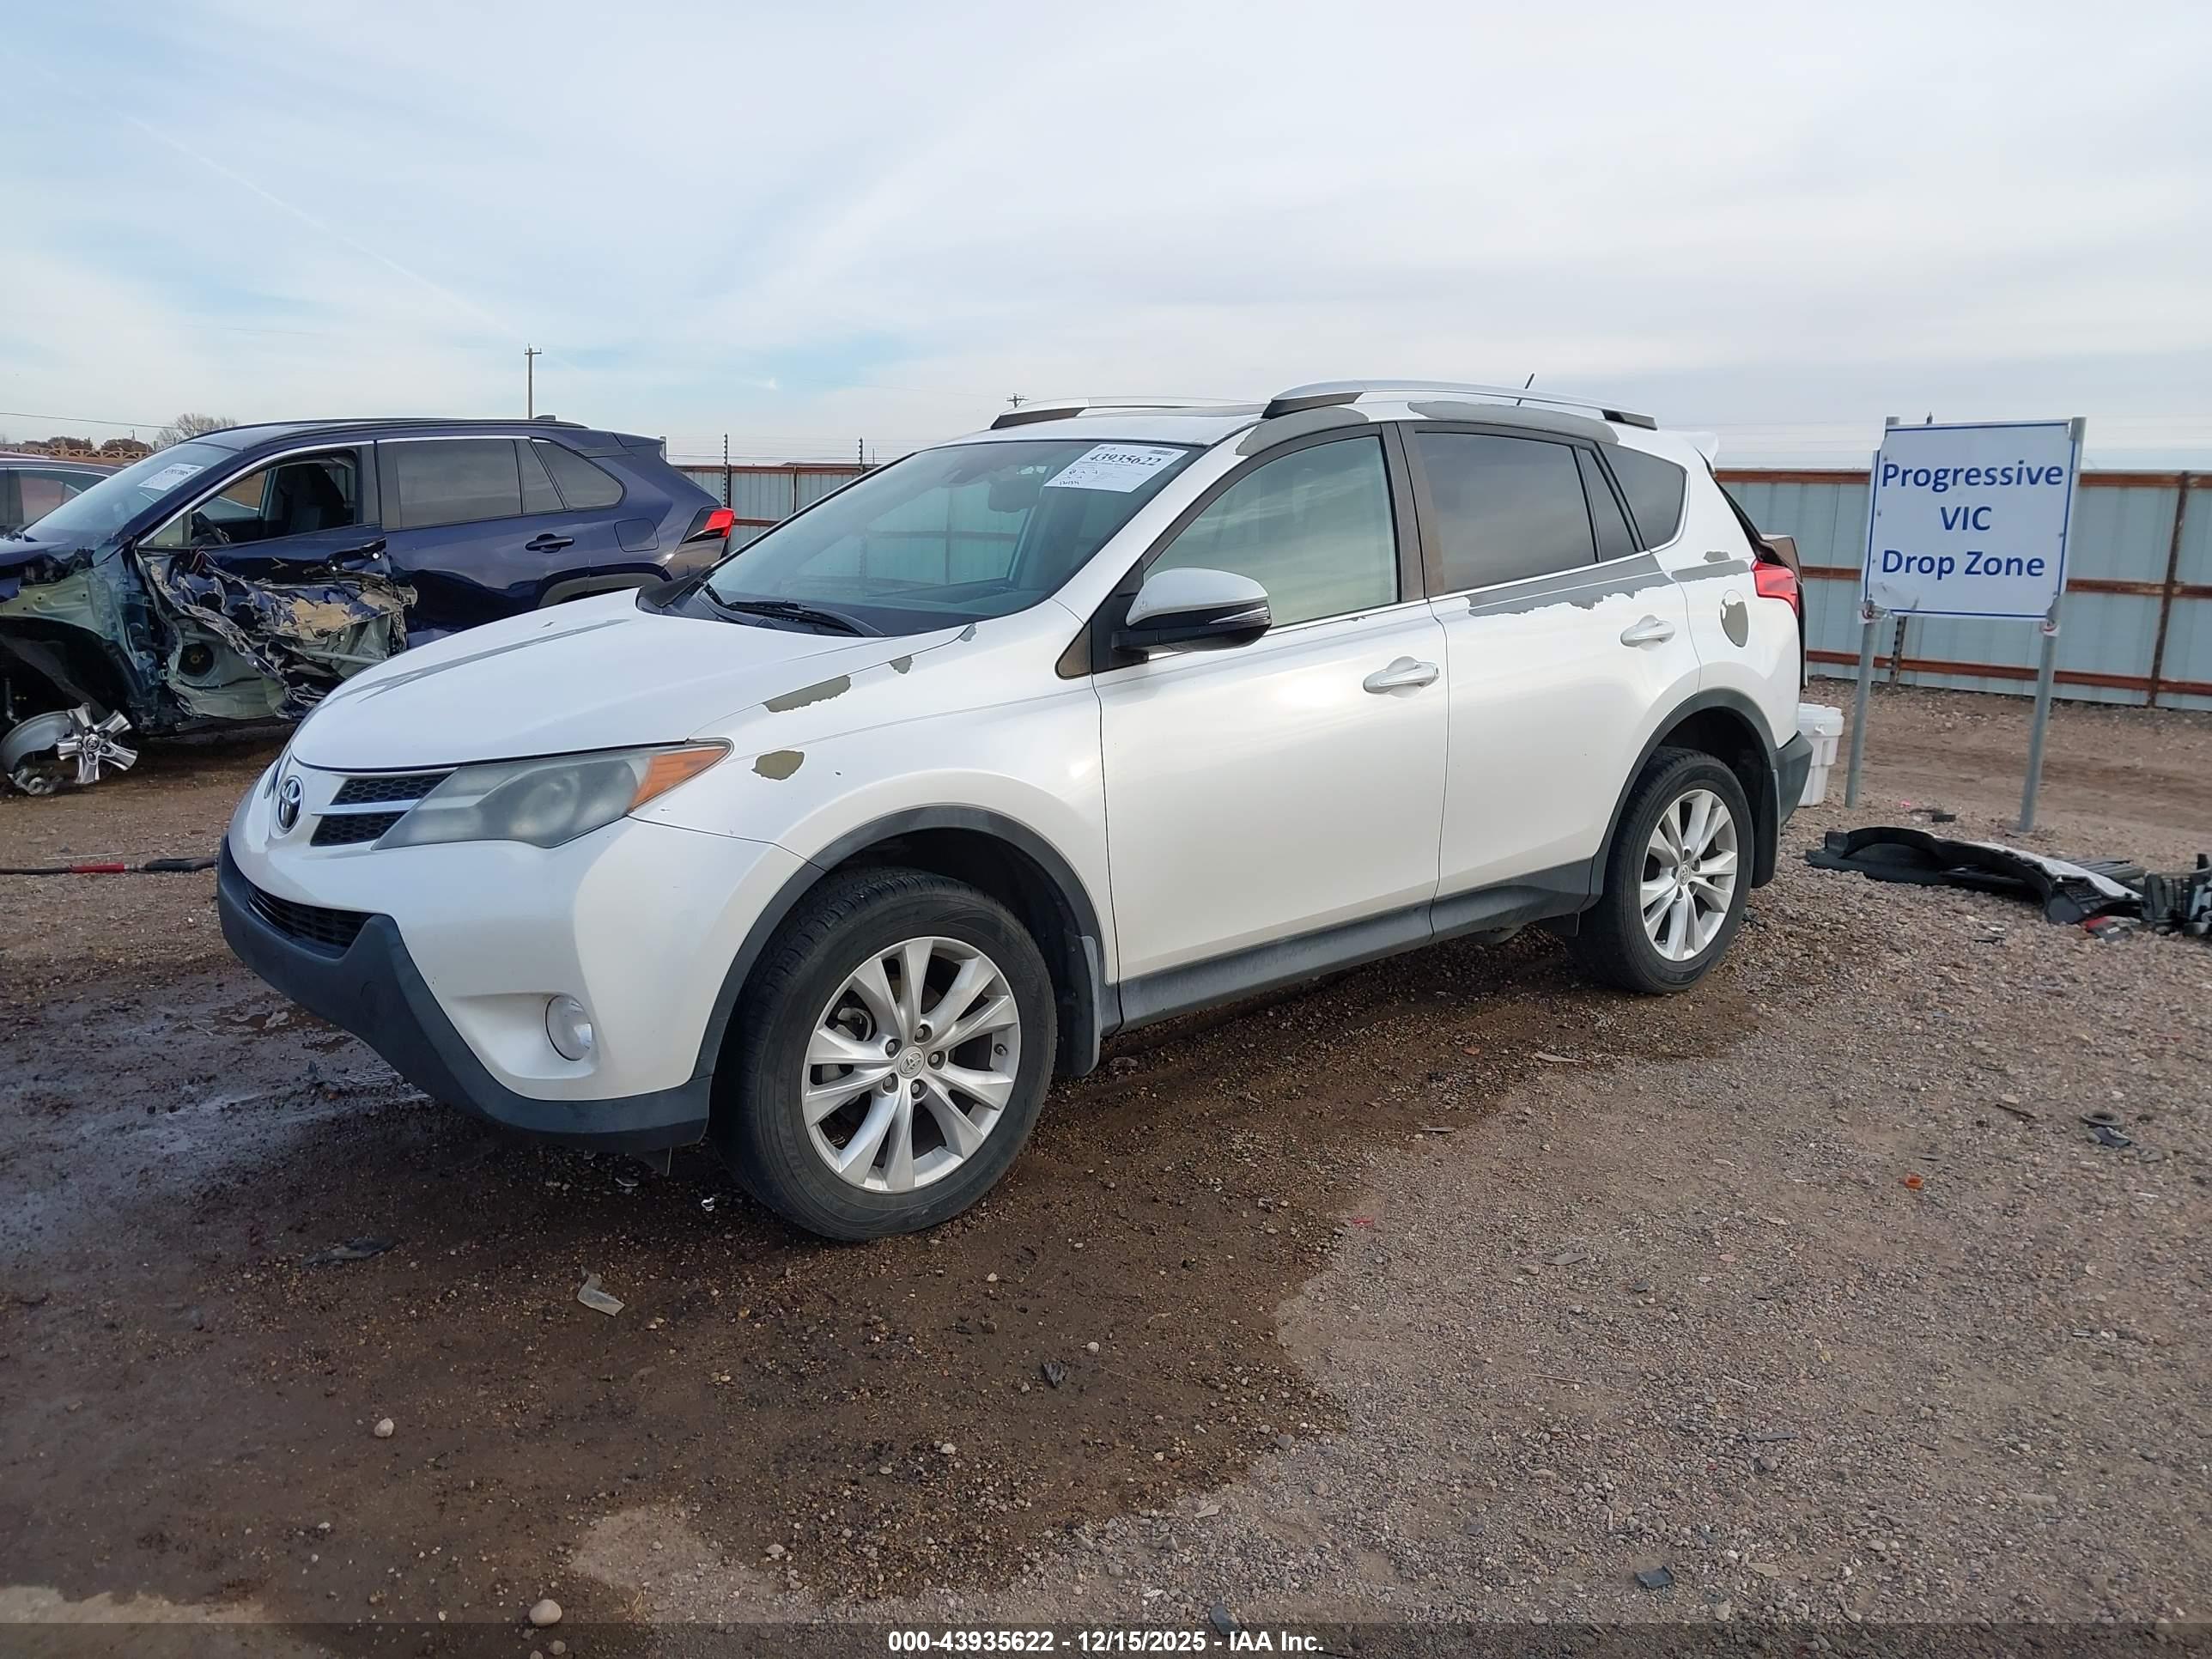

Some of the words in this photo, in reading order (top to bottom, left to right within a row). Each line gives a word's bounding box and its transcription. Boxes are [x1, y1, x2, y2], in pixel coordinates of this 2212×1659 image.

[1089, 453, 1162, 466] 43935622
[1881, 459, 2063, 493] Progressive
[1940, 506, 1992, 531] VIC
[1881, 549, 1955, 580] Drop
[1964, 551, 2045, 577] Zone
